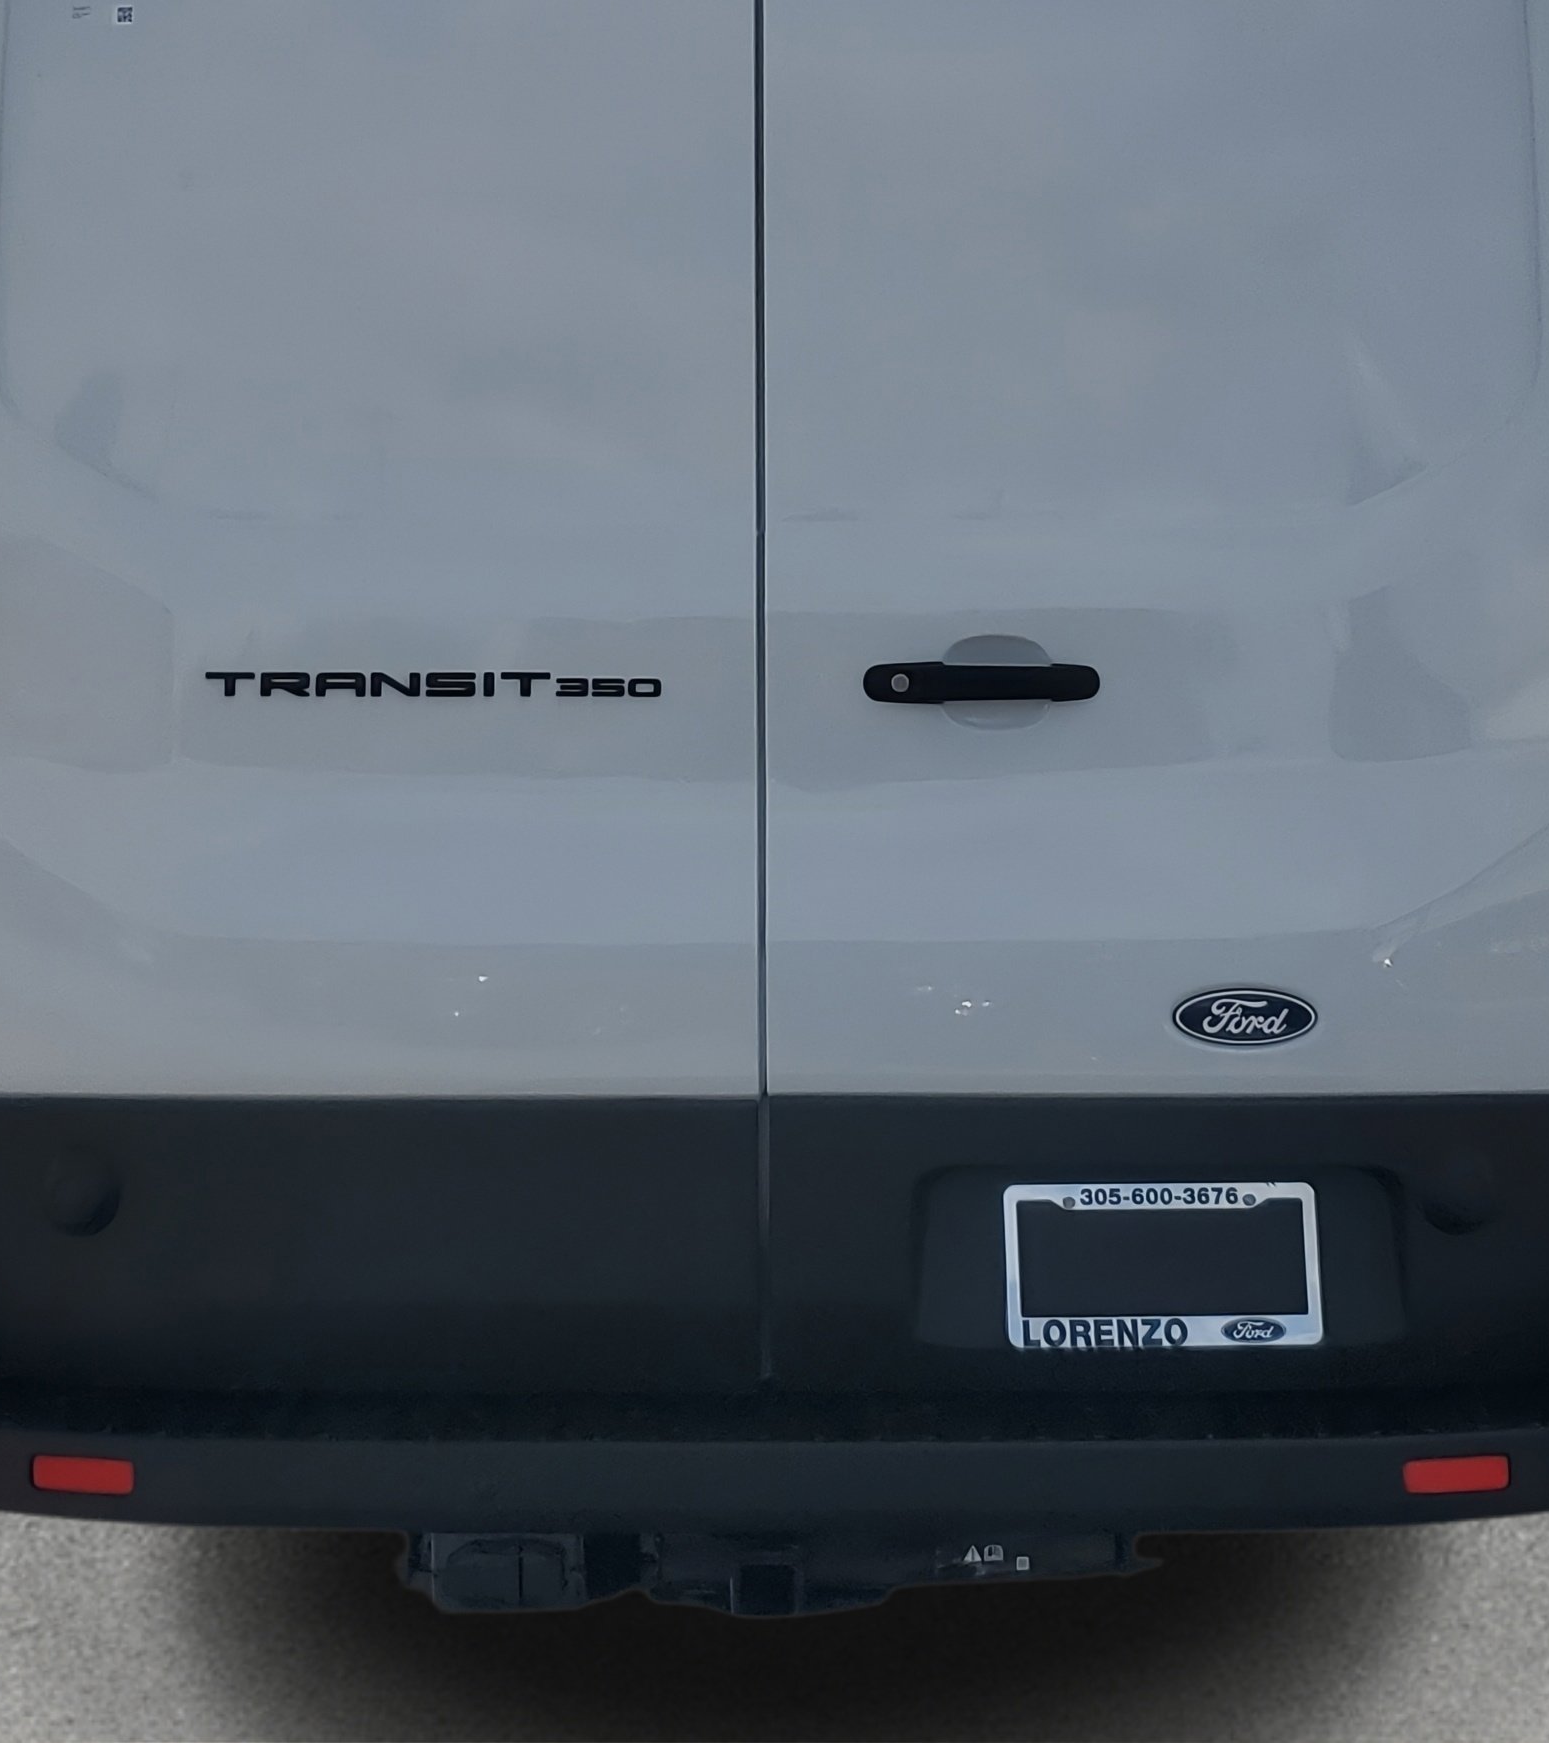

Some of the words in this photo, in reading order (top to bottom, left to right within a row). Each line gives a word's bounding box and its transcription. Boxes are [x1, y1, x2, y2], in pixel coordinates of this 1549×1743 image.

[1202, 998, 1290, 1035] Ford
[1079, 1186, 1239, 1207] 305-600-3676
[1021, 1317, 1189, 1347] LORENZO
[1232, 1320, 1275, 1339] Ford
